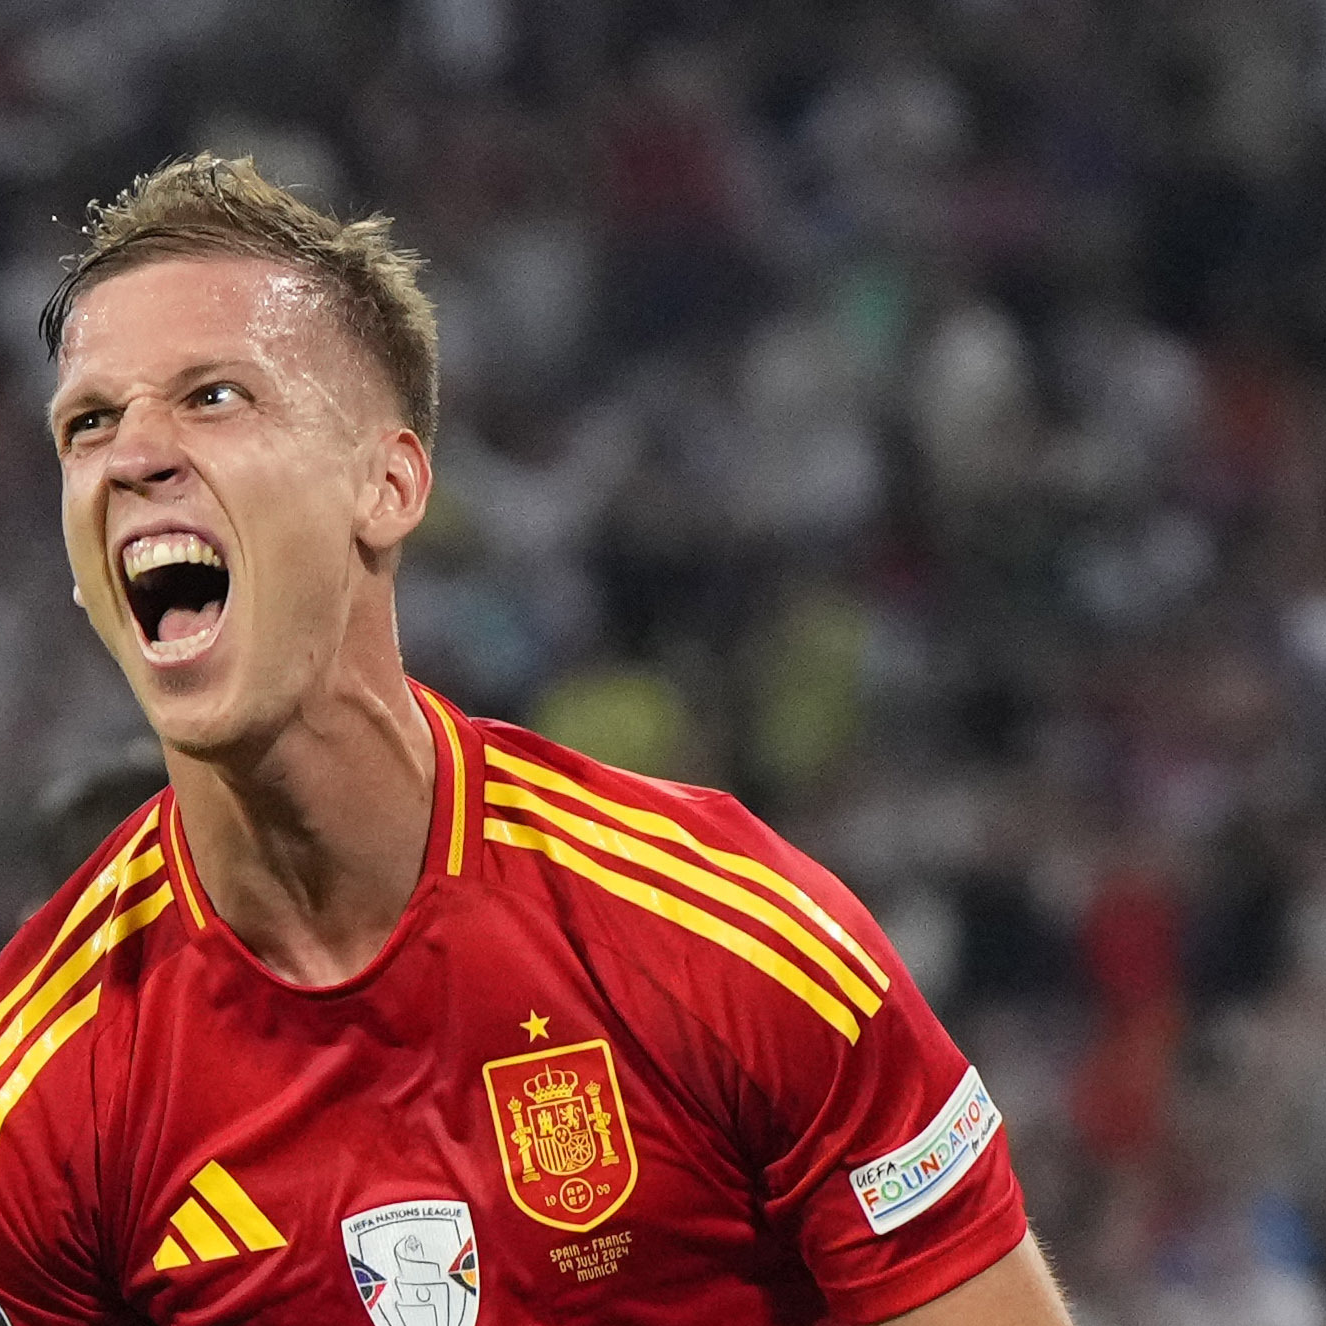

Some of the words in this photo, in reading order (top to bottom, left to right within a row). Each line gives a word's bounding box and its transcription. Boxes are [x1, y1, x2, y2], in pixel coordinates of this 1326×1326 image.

[855, 1161, 898, 1189] UEFA
[349, 1219, 375, 1233] UEFA
[375, 1207, 420, 1223] NATIONS
[422, 1207, 463, 1218] LEAGUE
[549, 1244, 581, 1262] SPAIN
[591, 1231, 633, 1252] FRANCE
[558, 1259, 574, 1273] 09
[575, 1252, 599, 1269] JULY
[601, 1245, 629, 1262] 2024
[576, 1261, 619, 1282] MUNICH
